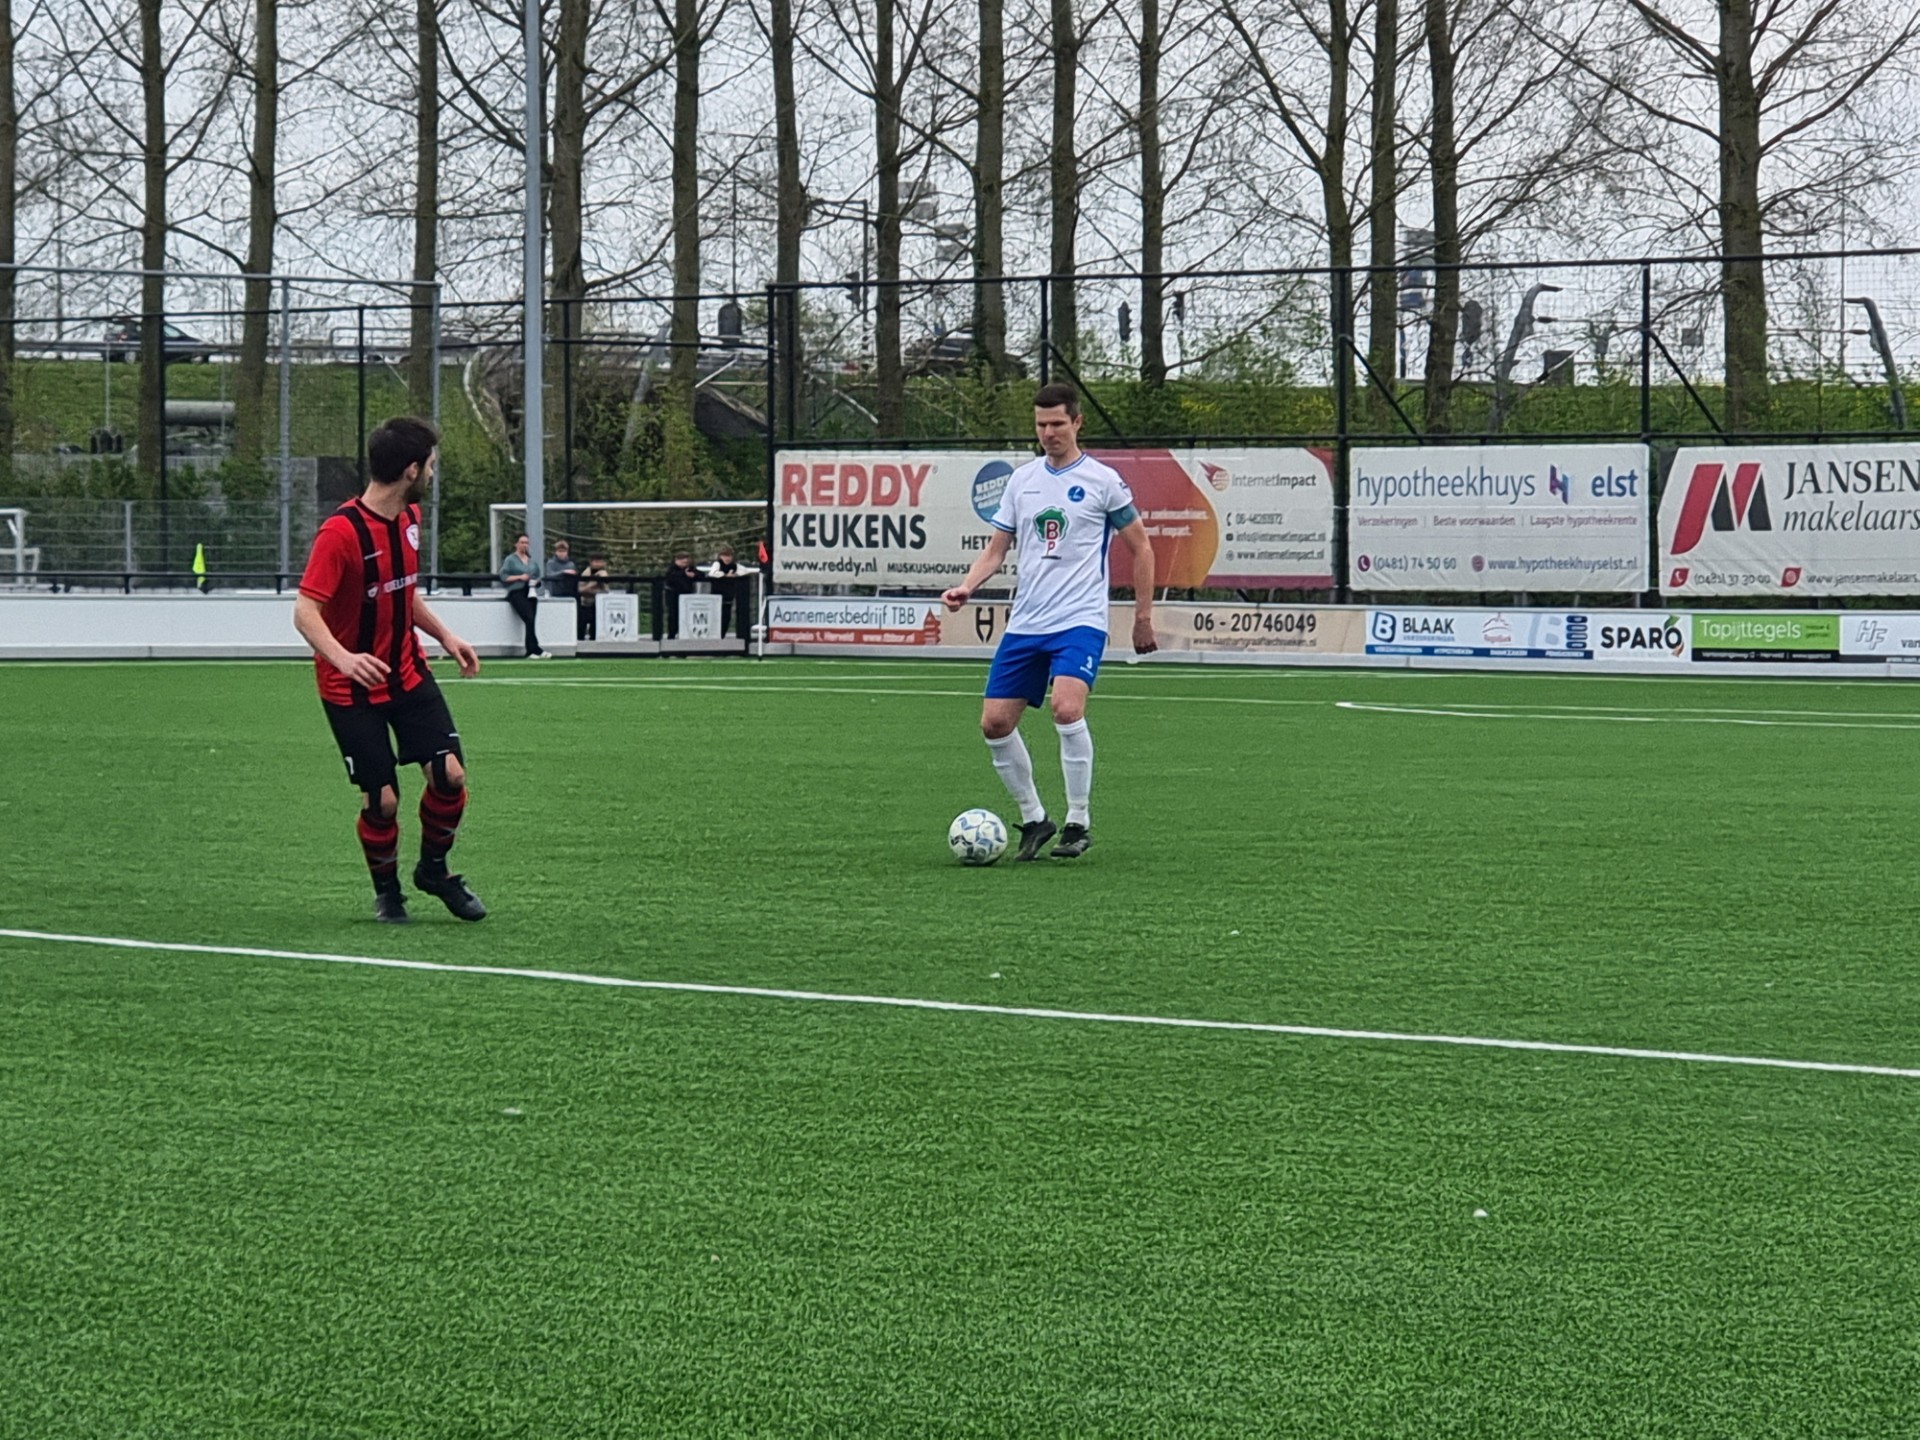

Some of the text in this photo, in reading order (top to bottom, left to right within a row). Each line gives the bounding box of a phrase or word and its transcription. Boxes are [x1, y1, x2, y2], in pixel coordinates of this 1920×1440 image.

[782, 463, 932, 507] REDDY
[1357, 466, 1536, 506] hypotheekhuys
[1591, 466, 1639, 498] elst
[1784, 459, 1920, 499] JANSEN
[1783, 500, 1920, 531] makelaars
[781, 513, 927, 550] KEUKENS
[1045, 520, 1059, 540] B
[781, 557, 878, 577] www.reddy.nl
[1373, 555, 1409, 572] (0481)
[1427, 557, 1441, 569] 50
[1488, 556, 1638, 573] www.hypotheekhuyselst.nl
[772, 605, 916, 629] Aannemersbedrijf TBB
[1193, 612, 1215, 632] 06
[1230, 613, 1317, 633] 20746049
[1372, 612, 1397, 643] B
[1402, 617, 1455, 634] BLAAK
[1699, 619, 1801, 642] Tapijttegels
